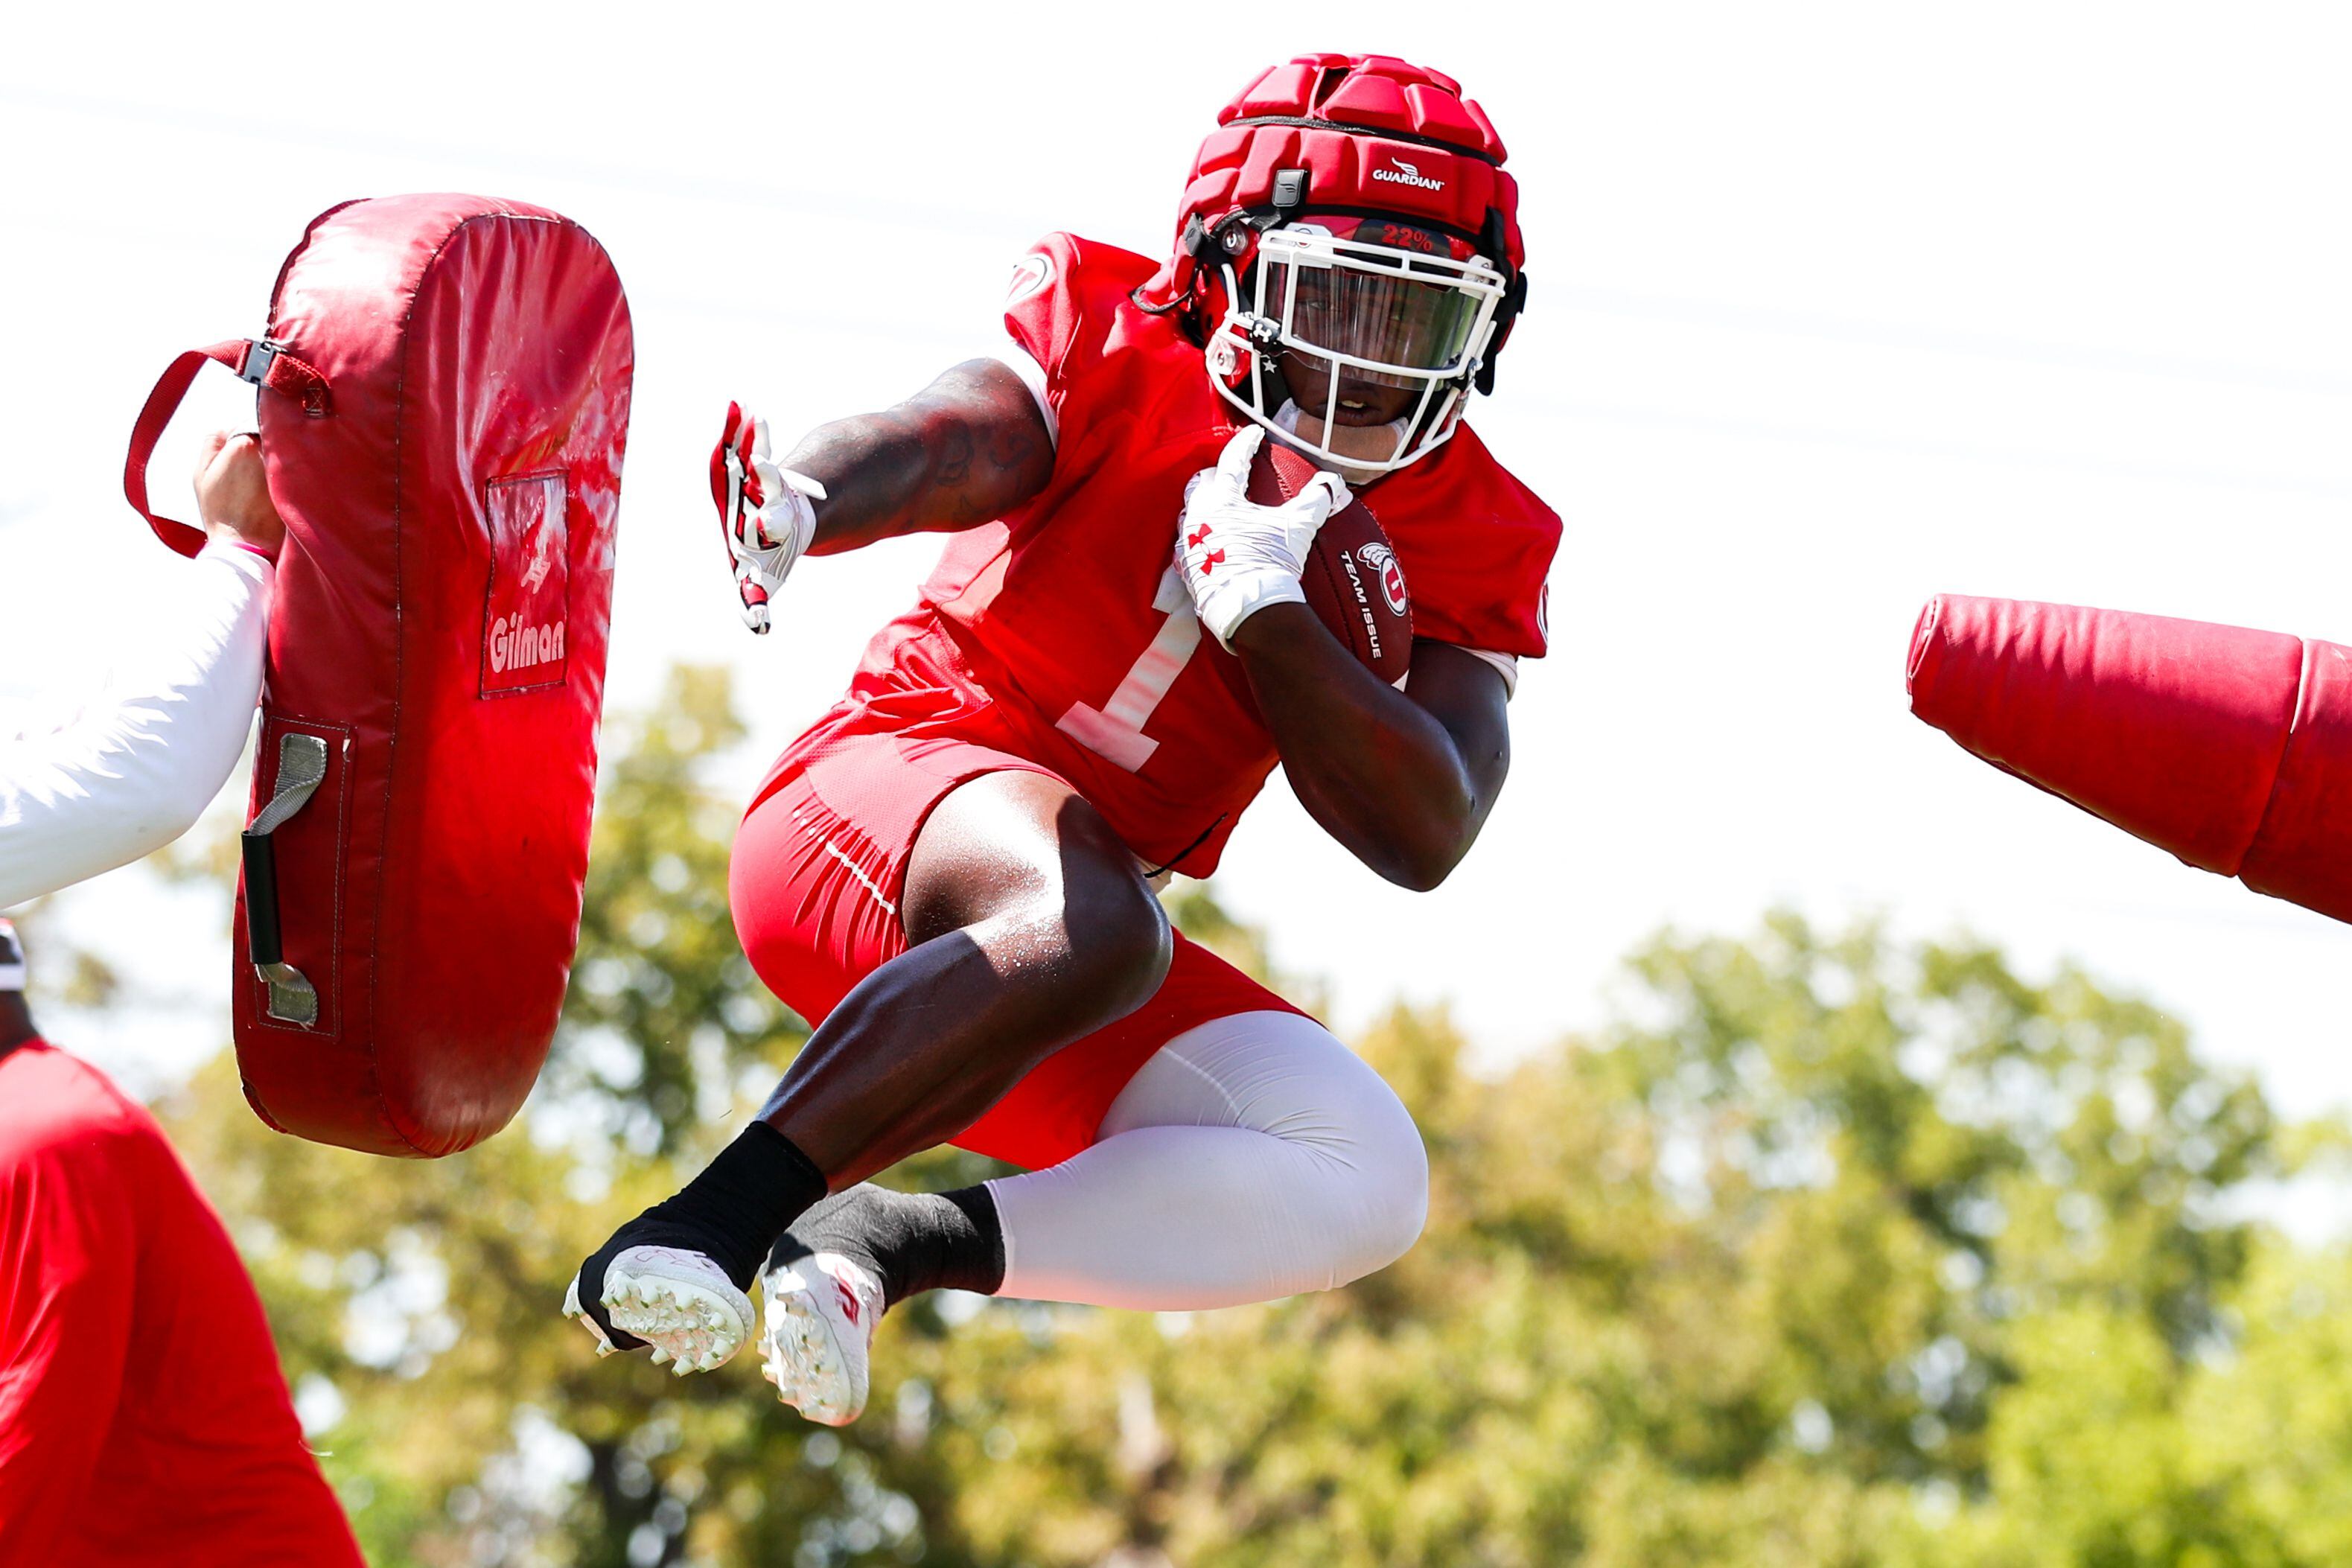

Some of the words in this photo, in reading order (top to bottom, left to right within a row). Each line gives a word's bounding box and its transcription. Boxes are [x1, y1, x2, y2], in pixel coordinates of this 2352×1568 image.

[1372, 169, 1442, 191] GUARDIAN
[1381, 224, 1433, 252] 22%
[1341, 550, 1367, 603] TEAM
[1362, 608, 1382, 659] ISSUE
[490, 611, 564, 674] Gilman
[1054, 566, 1202, 774] 1
